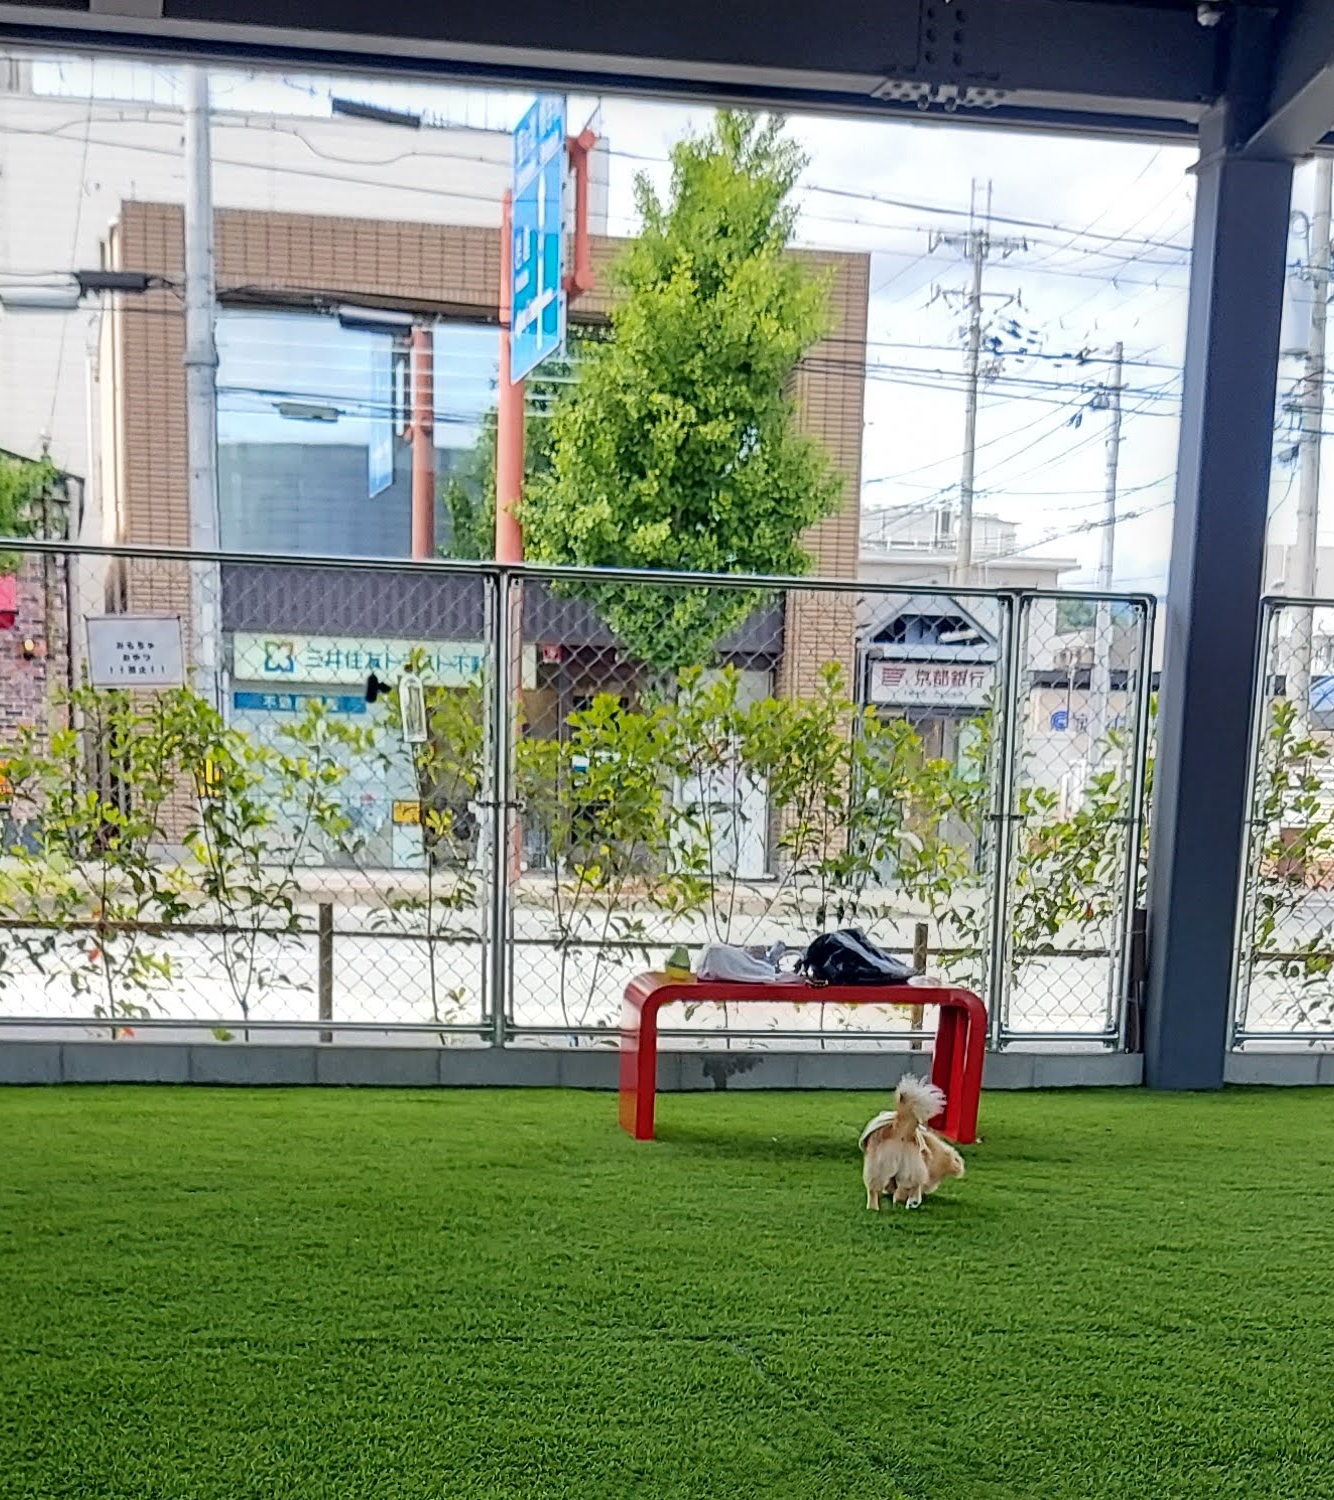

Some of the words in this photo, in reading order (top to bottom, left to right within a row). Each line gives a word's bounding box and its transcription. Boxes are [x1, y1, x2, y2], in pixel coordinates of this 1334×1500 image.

[304, 646, 481, 676] 三井住友トスト不
[914, 667, 985, 689] 京都銀行
